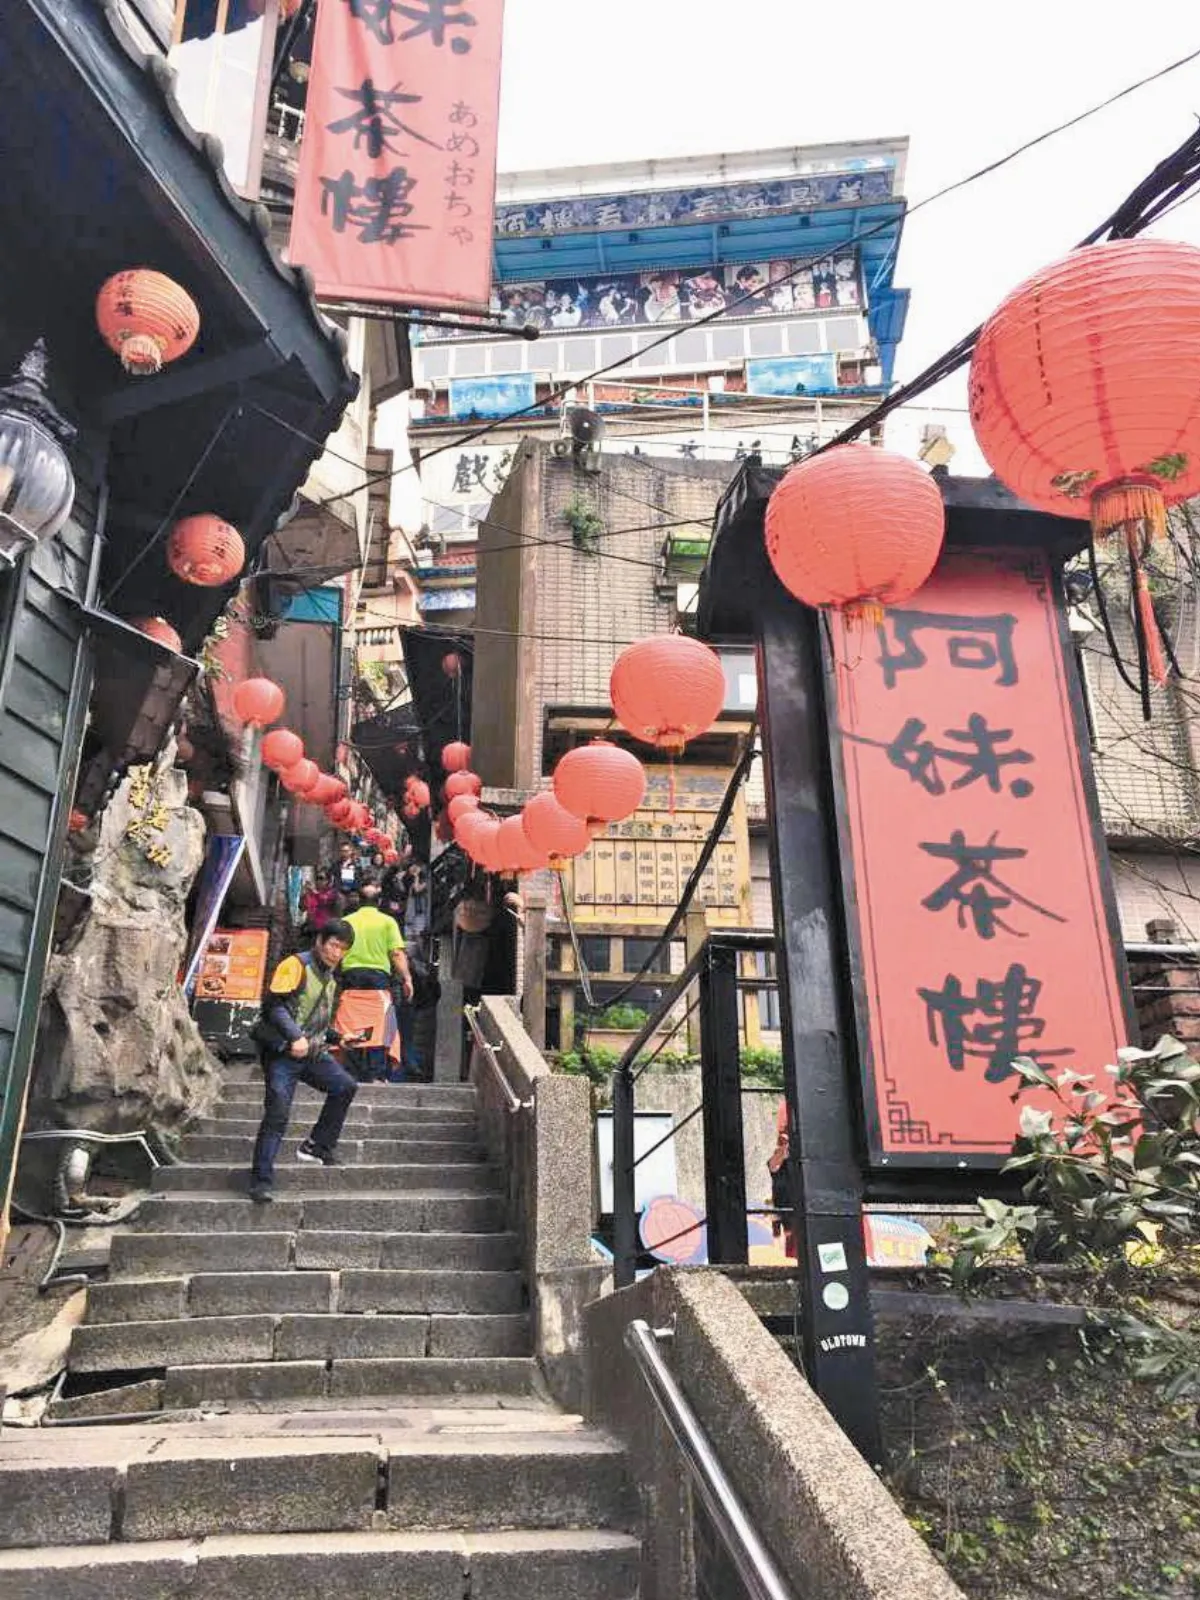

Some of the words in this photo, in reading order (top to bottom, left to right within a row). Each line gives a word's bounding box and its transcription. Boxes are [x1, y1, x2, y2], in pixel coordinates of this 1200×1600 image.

[443, 100, 480, 246] あめおちゃ
[838, 607, 1075, 1083] 阿妹茶樓
[820, 1334, 866, 1351] OLDTOWN
